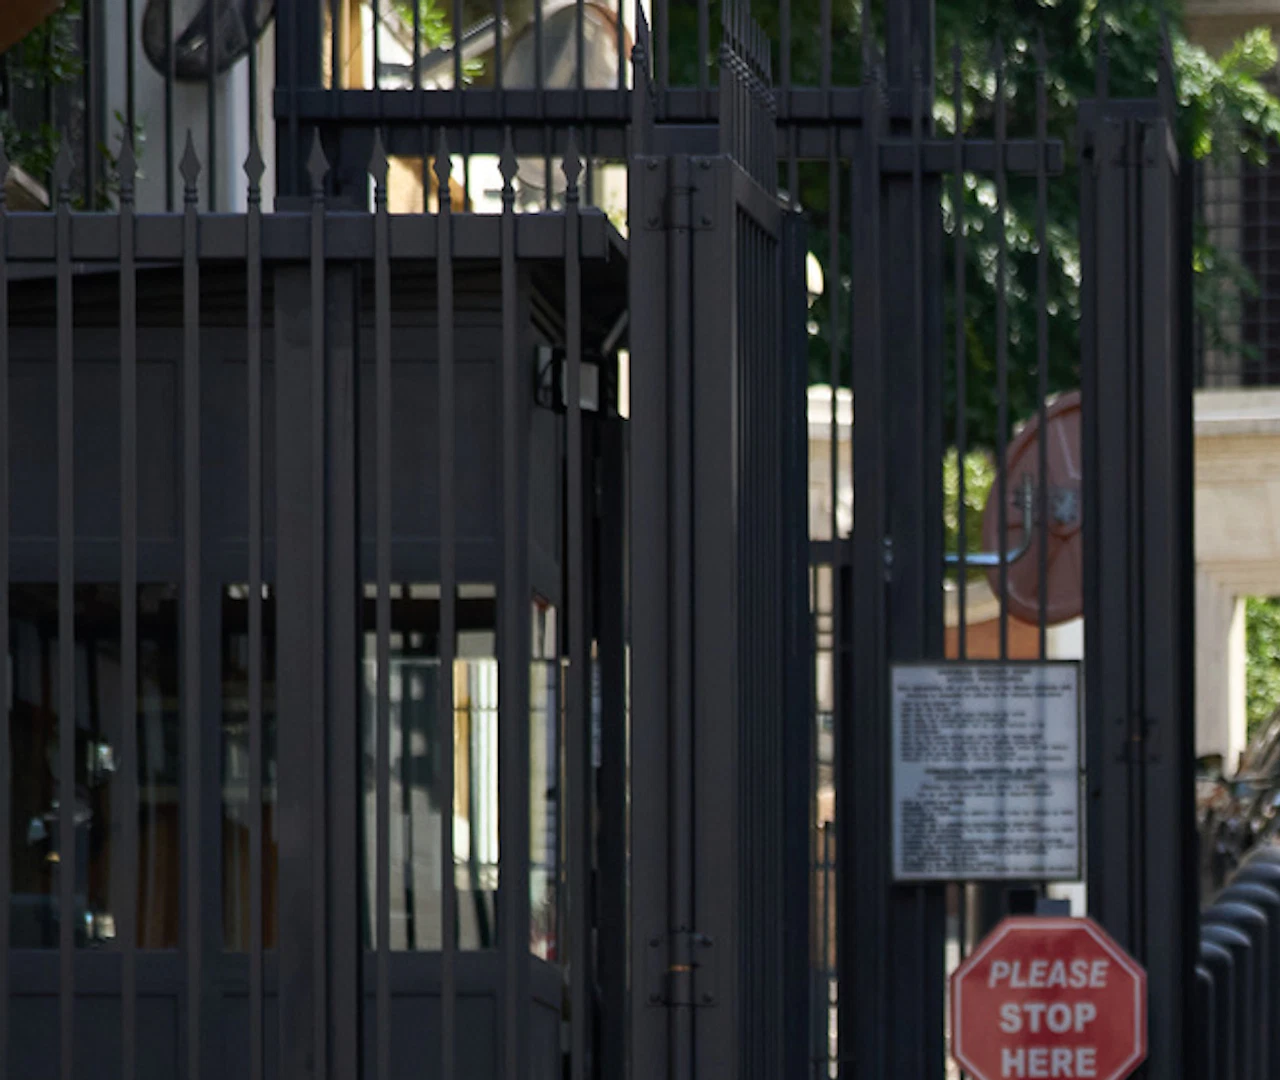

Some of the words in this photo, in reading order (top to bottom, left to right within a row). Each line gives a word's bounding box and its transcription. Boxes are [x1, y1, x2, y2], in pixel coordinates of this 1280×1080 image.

[988, 959, 1109, 989] PLEASE
[999, 1003, 1097, 1034] STOP
[1001, 1047, 1097, 1078] HERE
